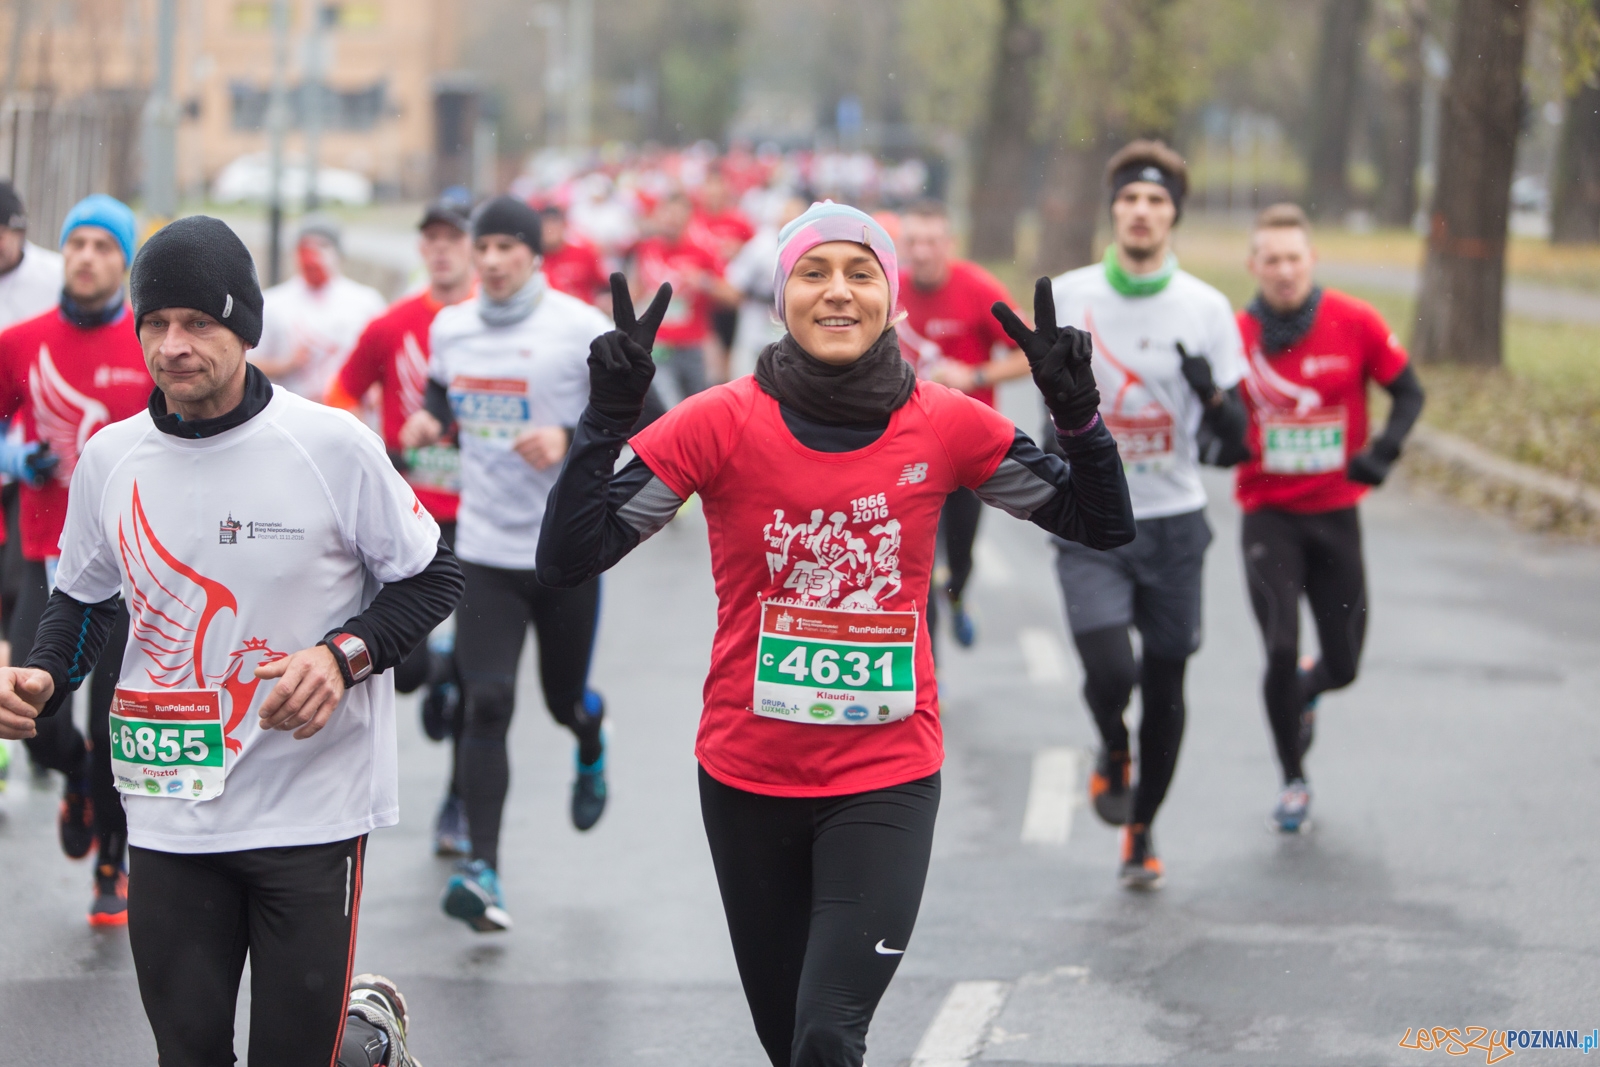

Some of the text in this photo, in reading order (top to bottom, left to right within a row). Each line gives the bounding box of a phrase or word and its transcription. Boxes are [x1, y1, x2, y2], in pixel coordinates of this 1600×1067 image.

[850, 492, 886, 511] 1966
[852, 505, 889, 524] 2016
[246, 521, 255, 539] 1
[848, 625, 907, 636] RunPoland.org
[778, 646, 893, 687] 4631
[816, 691, 855, 702] Klaudia
[154, 704, 210, 713] RunPoland.org
[761, 698, 786, 708] GRUPA
[761, 705, 790, 715] LUXMED
[120, 724, 209, 762] 6855
[142, 767, 178, 778] Krzysztof
